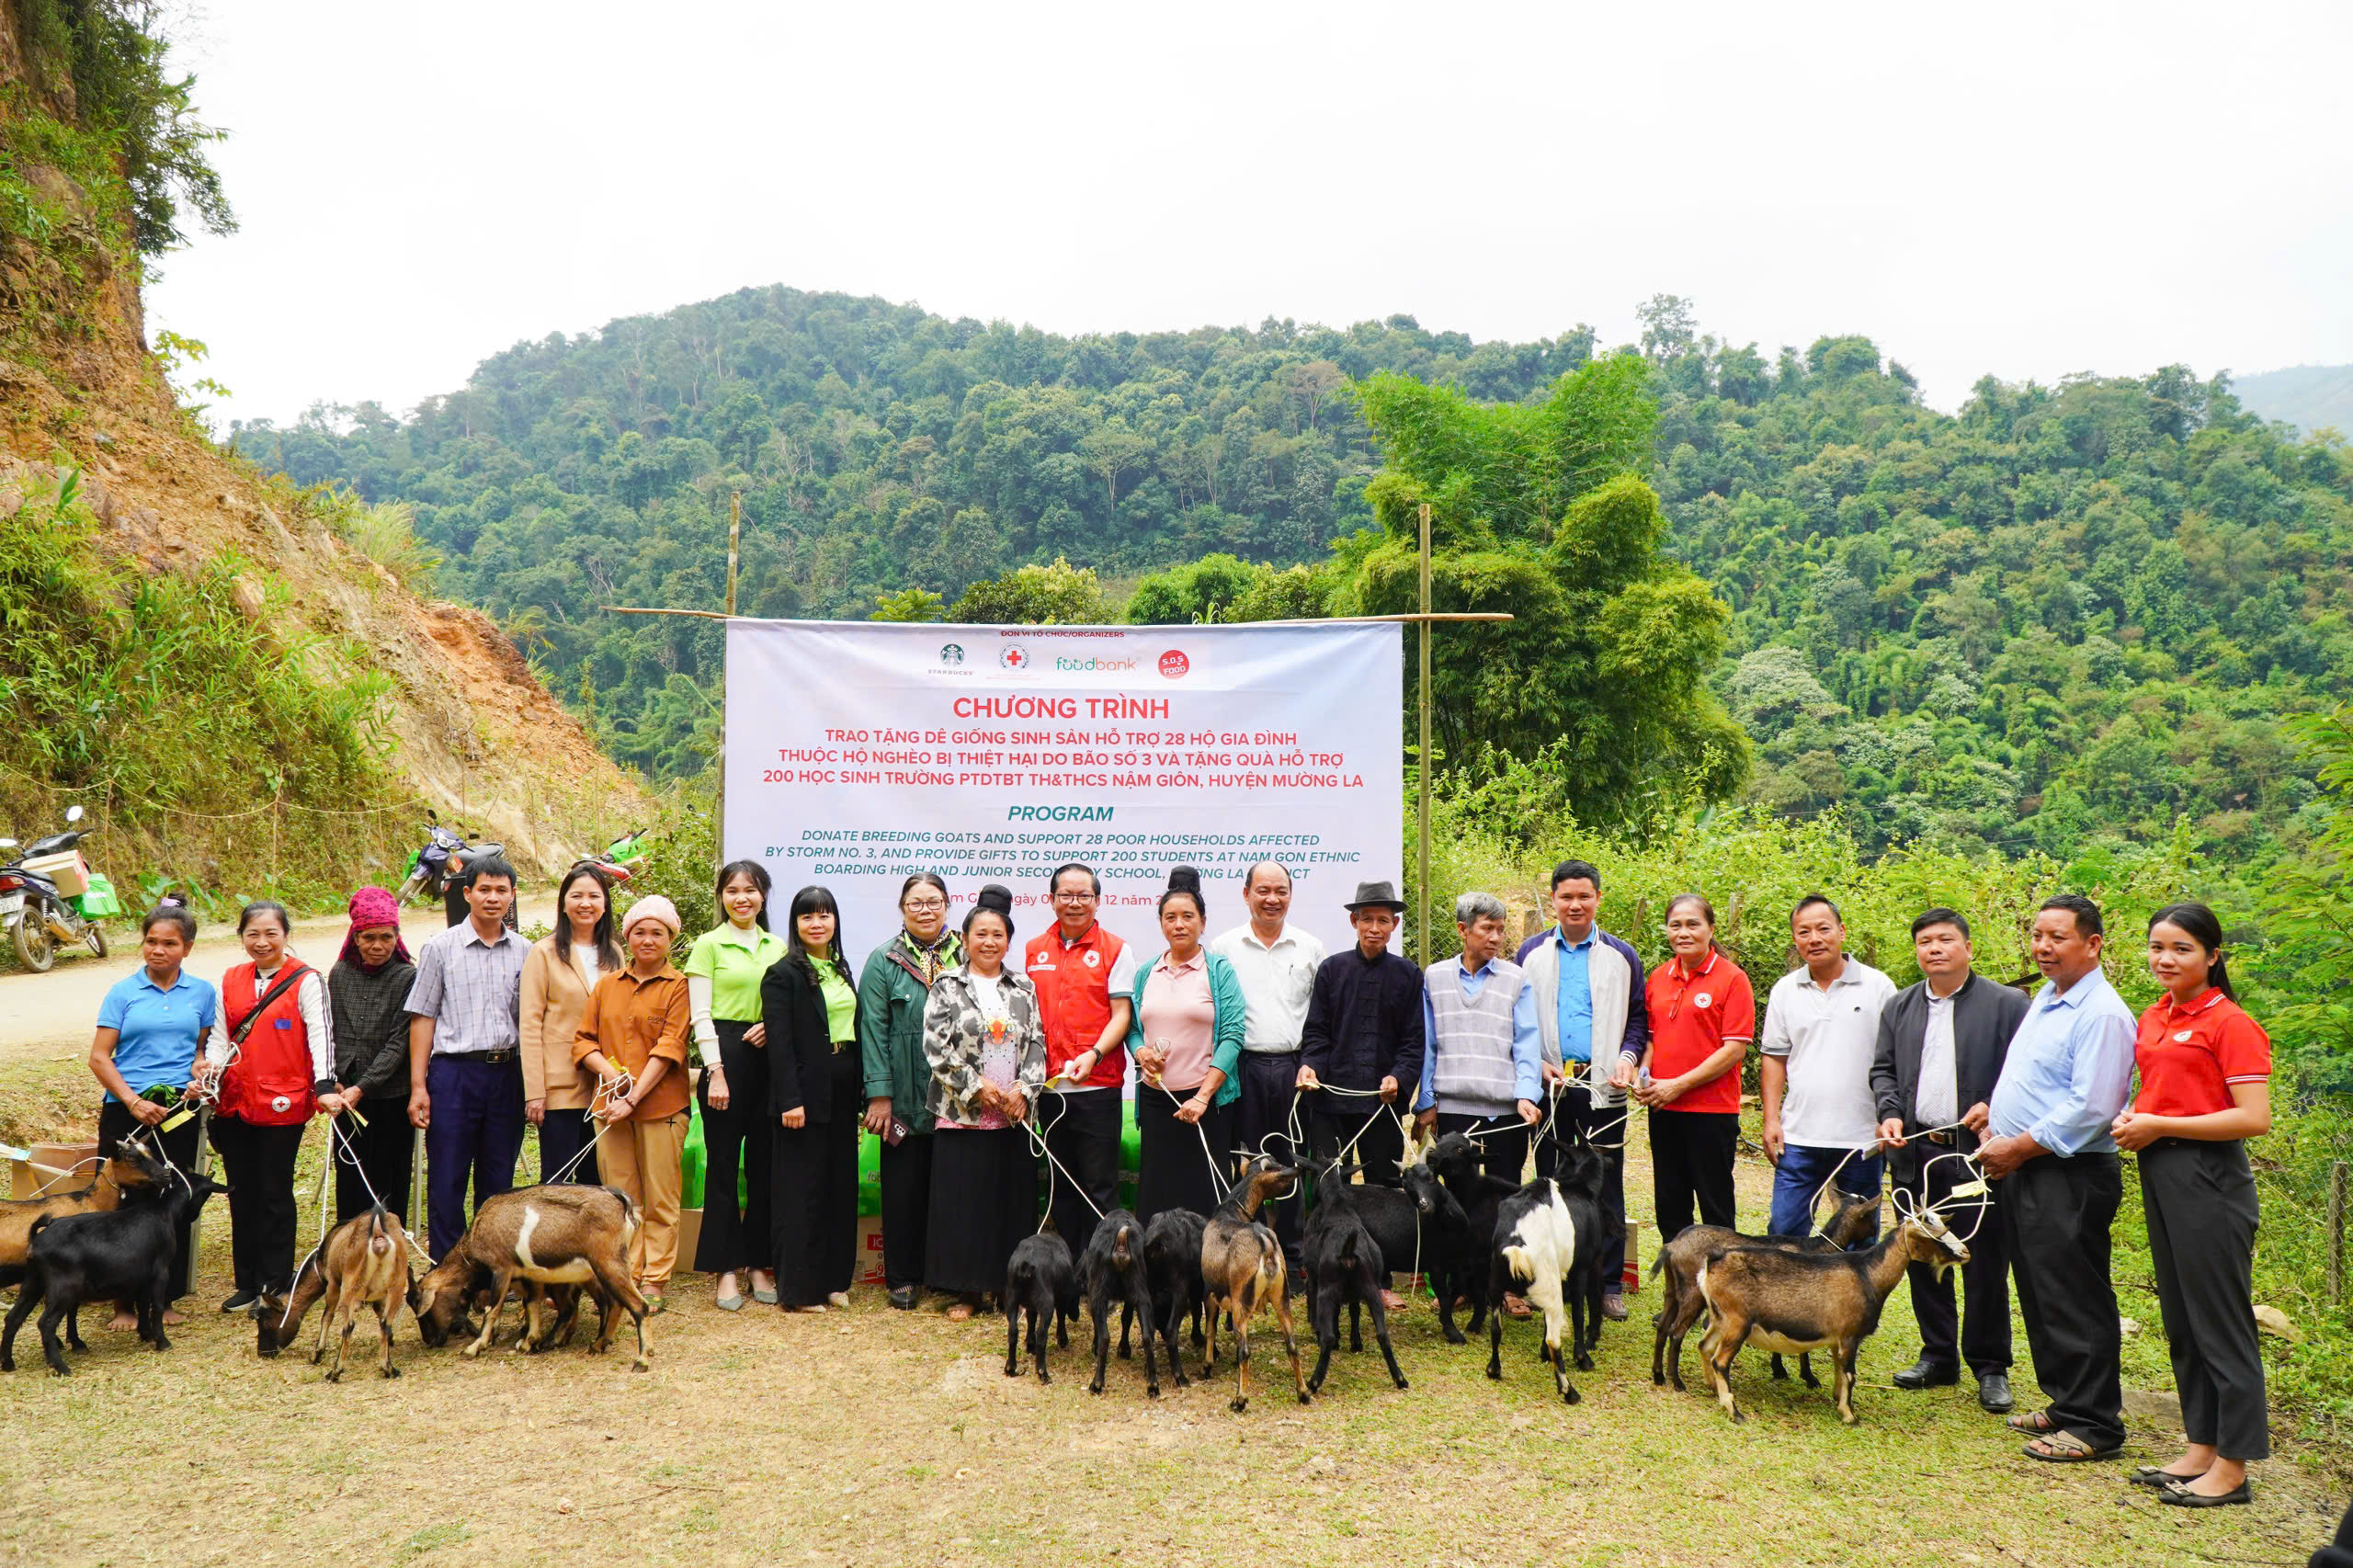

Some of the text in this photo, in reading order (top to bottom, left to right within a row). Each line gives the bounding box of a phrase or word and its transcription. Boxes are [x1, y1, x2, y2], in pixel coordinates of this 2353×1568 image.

[1163, 665, 1186, 676] FOOD
[953, 693, 1169, 719] CHƯƠNG TRÌNH
[825, 727, 1297, 748] TRAO TẶNG DÊ GIỐNG SINH SẢN HỖ TRỢ 28 HỘ GIA ĐÌNH
[779, 746, 1344, 769] THUỘC HỘ NGHÈO BỊ THIỆT HẠI DO BÃO SỐ 3 VÀ TẶNG QUÀ HỖ TRỢ
[764, 769, 1364, 790] 200 HỌC SINH TRƯỜNG PTDTBT TH&THCS NẬM GIÔN, HUYỆN MƯỜNG LA
[1008, 806, 1114, 823] PROGRAM
[801, 831, 1320, 846] DONATE BREEDING GOATS AND SUPPORT 28 POOR HOUSEHOLDS AFFECTED
[765, 846, 1360, 863] BY STORM NO. 3, AND PROVIDE GIFTS TO SUPPORT 200 STUDENTS AT NAM GON ETHNIC
[814, 864, 886, 875] BOARDING
[890, 865, 926, 876] HIGH
[930, 866, 959, 876] AND
[962, 866, 1013, 877] JUNIOR
[1017, 867, 1102, 879] SECOY
[1105, 868, 1165, 880] SCHOOL,
[1227, 869, 1244, 880] LA
[1105, 895, 1118, 905] 12
[1121, 894, 1152, 905] năm
